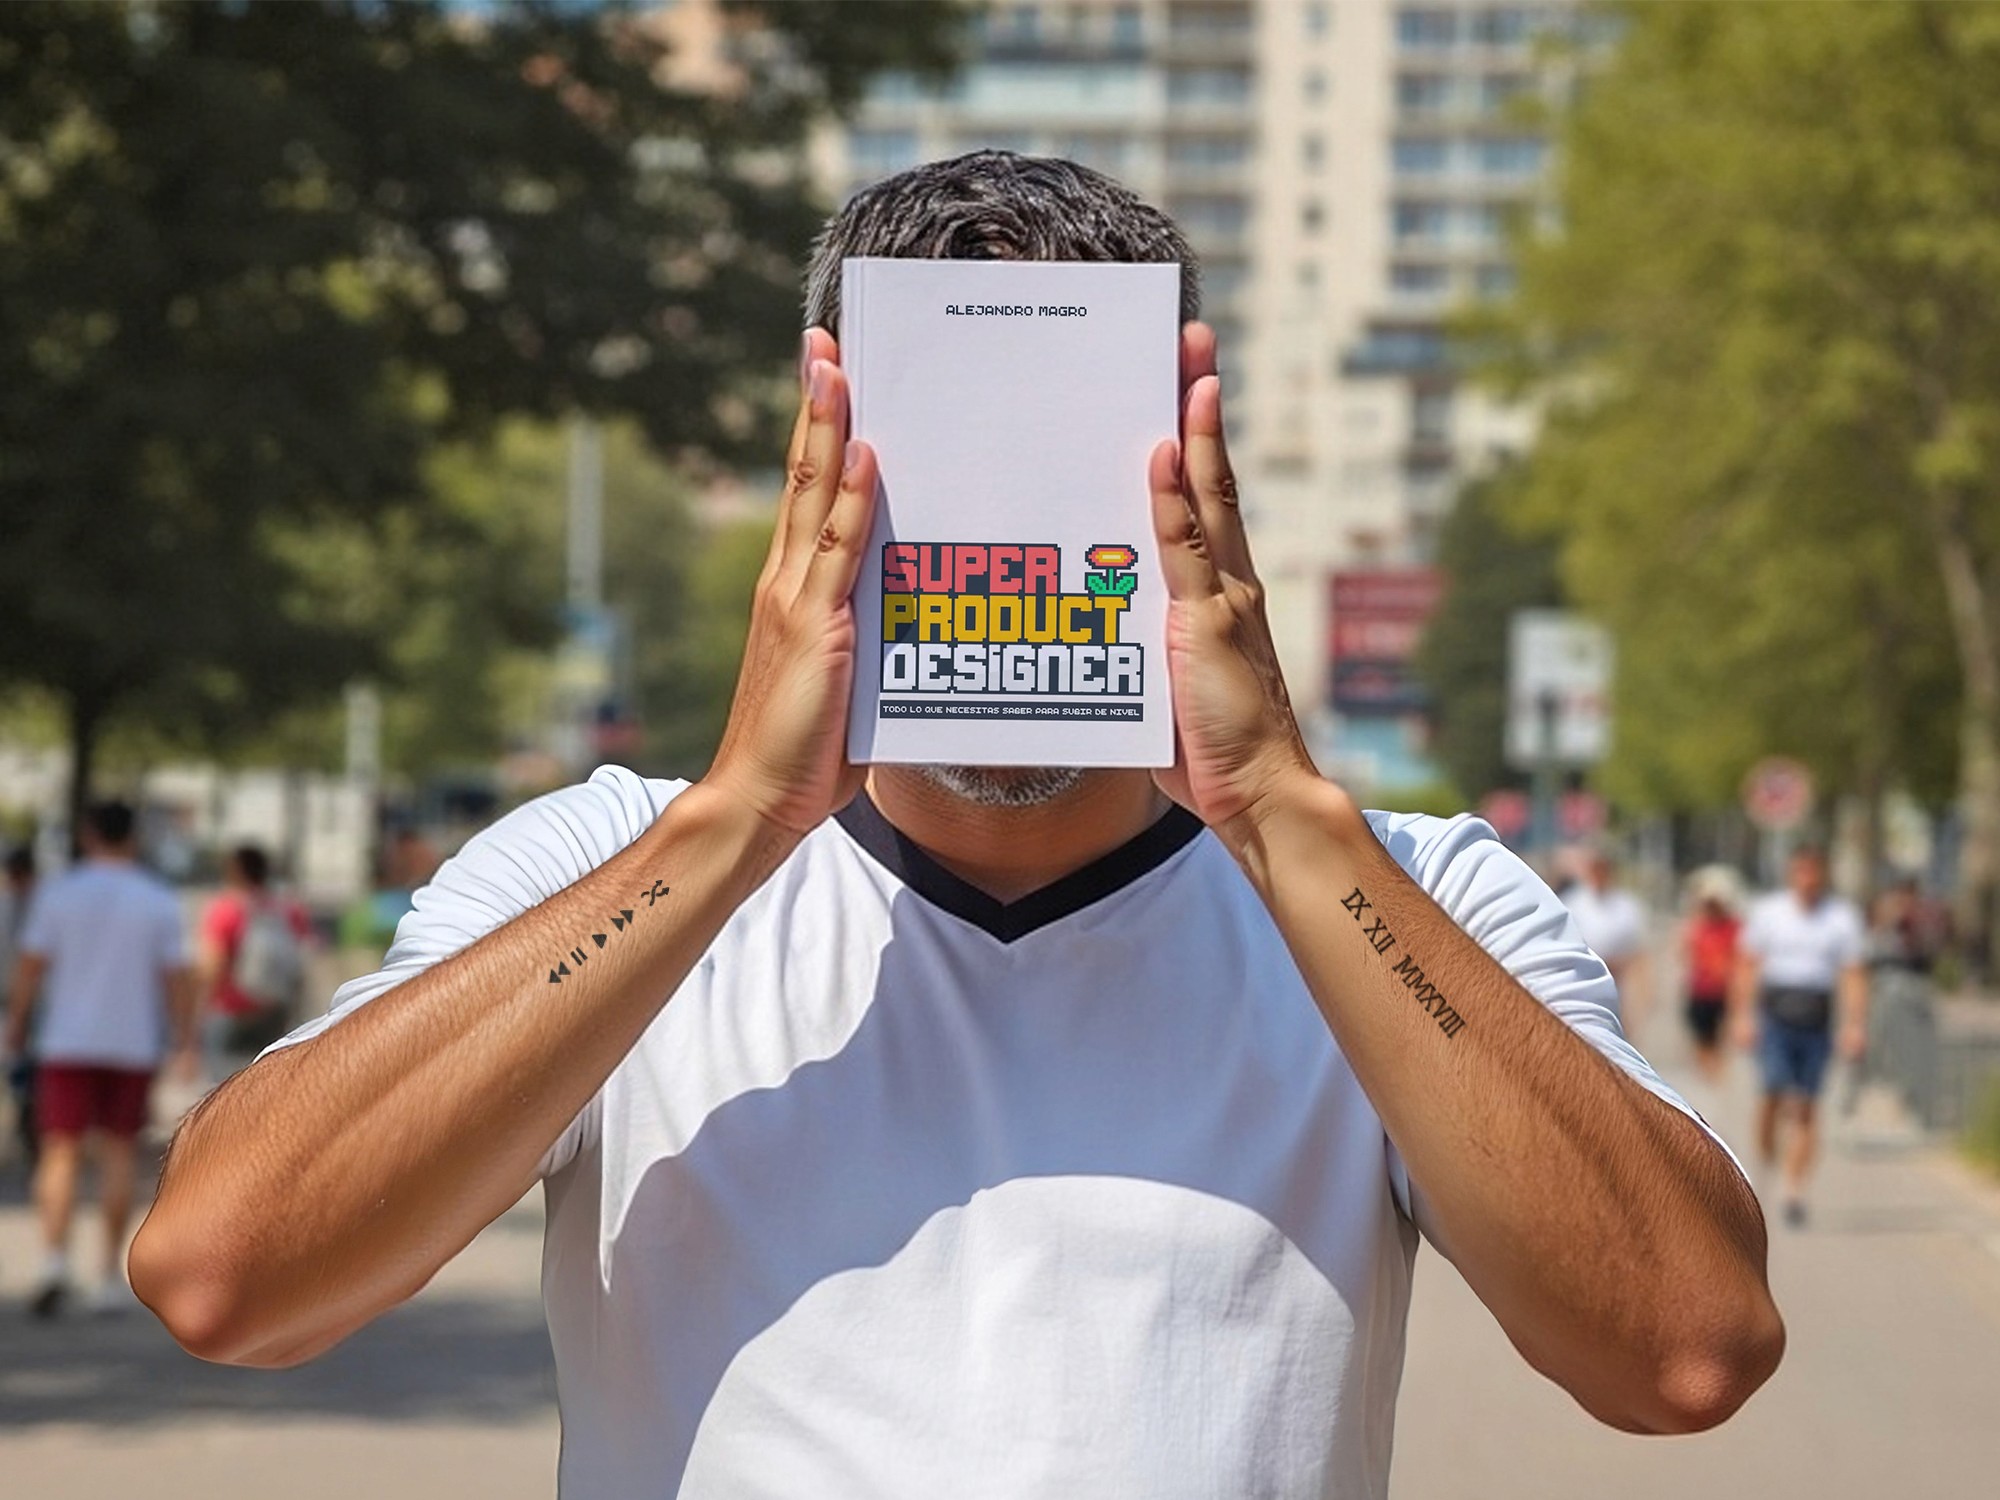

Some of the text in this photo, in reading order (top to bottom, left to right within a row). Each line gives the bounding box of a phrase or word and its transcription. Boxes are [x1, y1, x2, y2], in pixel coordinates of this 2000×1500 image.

[945, 304, 1088, 317] ALEJANDRO MAGRO
[882, 542, 1061, 594] SUPER
[882, 593, 1131, 644] PRODUCT
[883, 705, 1140, 717] TODO LO QUE NECESITAS SABER PARA SUBIR DE NIVEL
[1340, 887, 1466, 1039] IX XII MMXVIII
